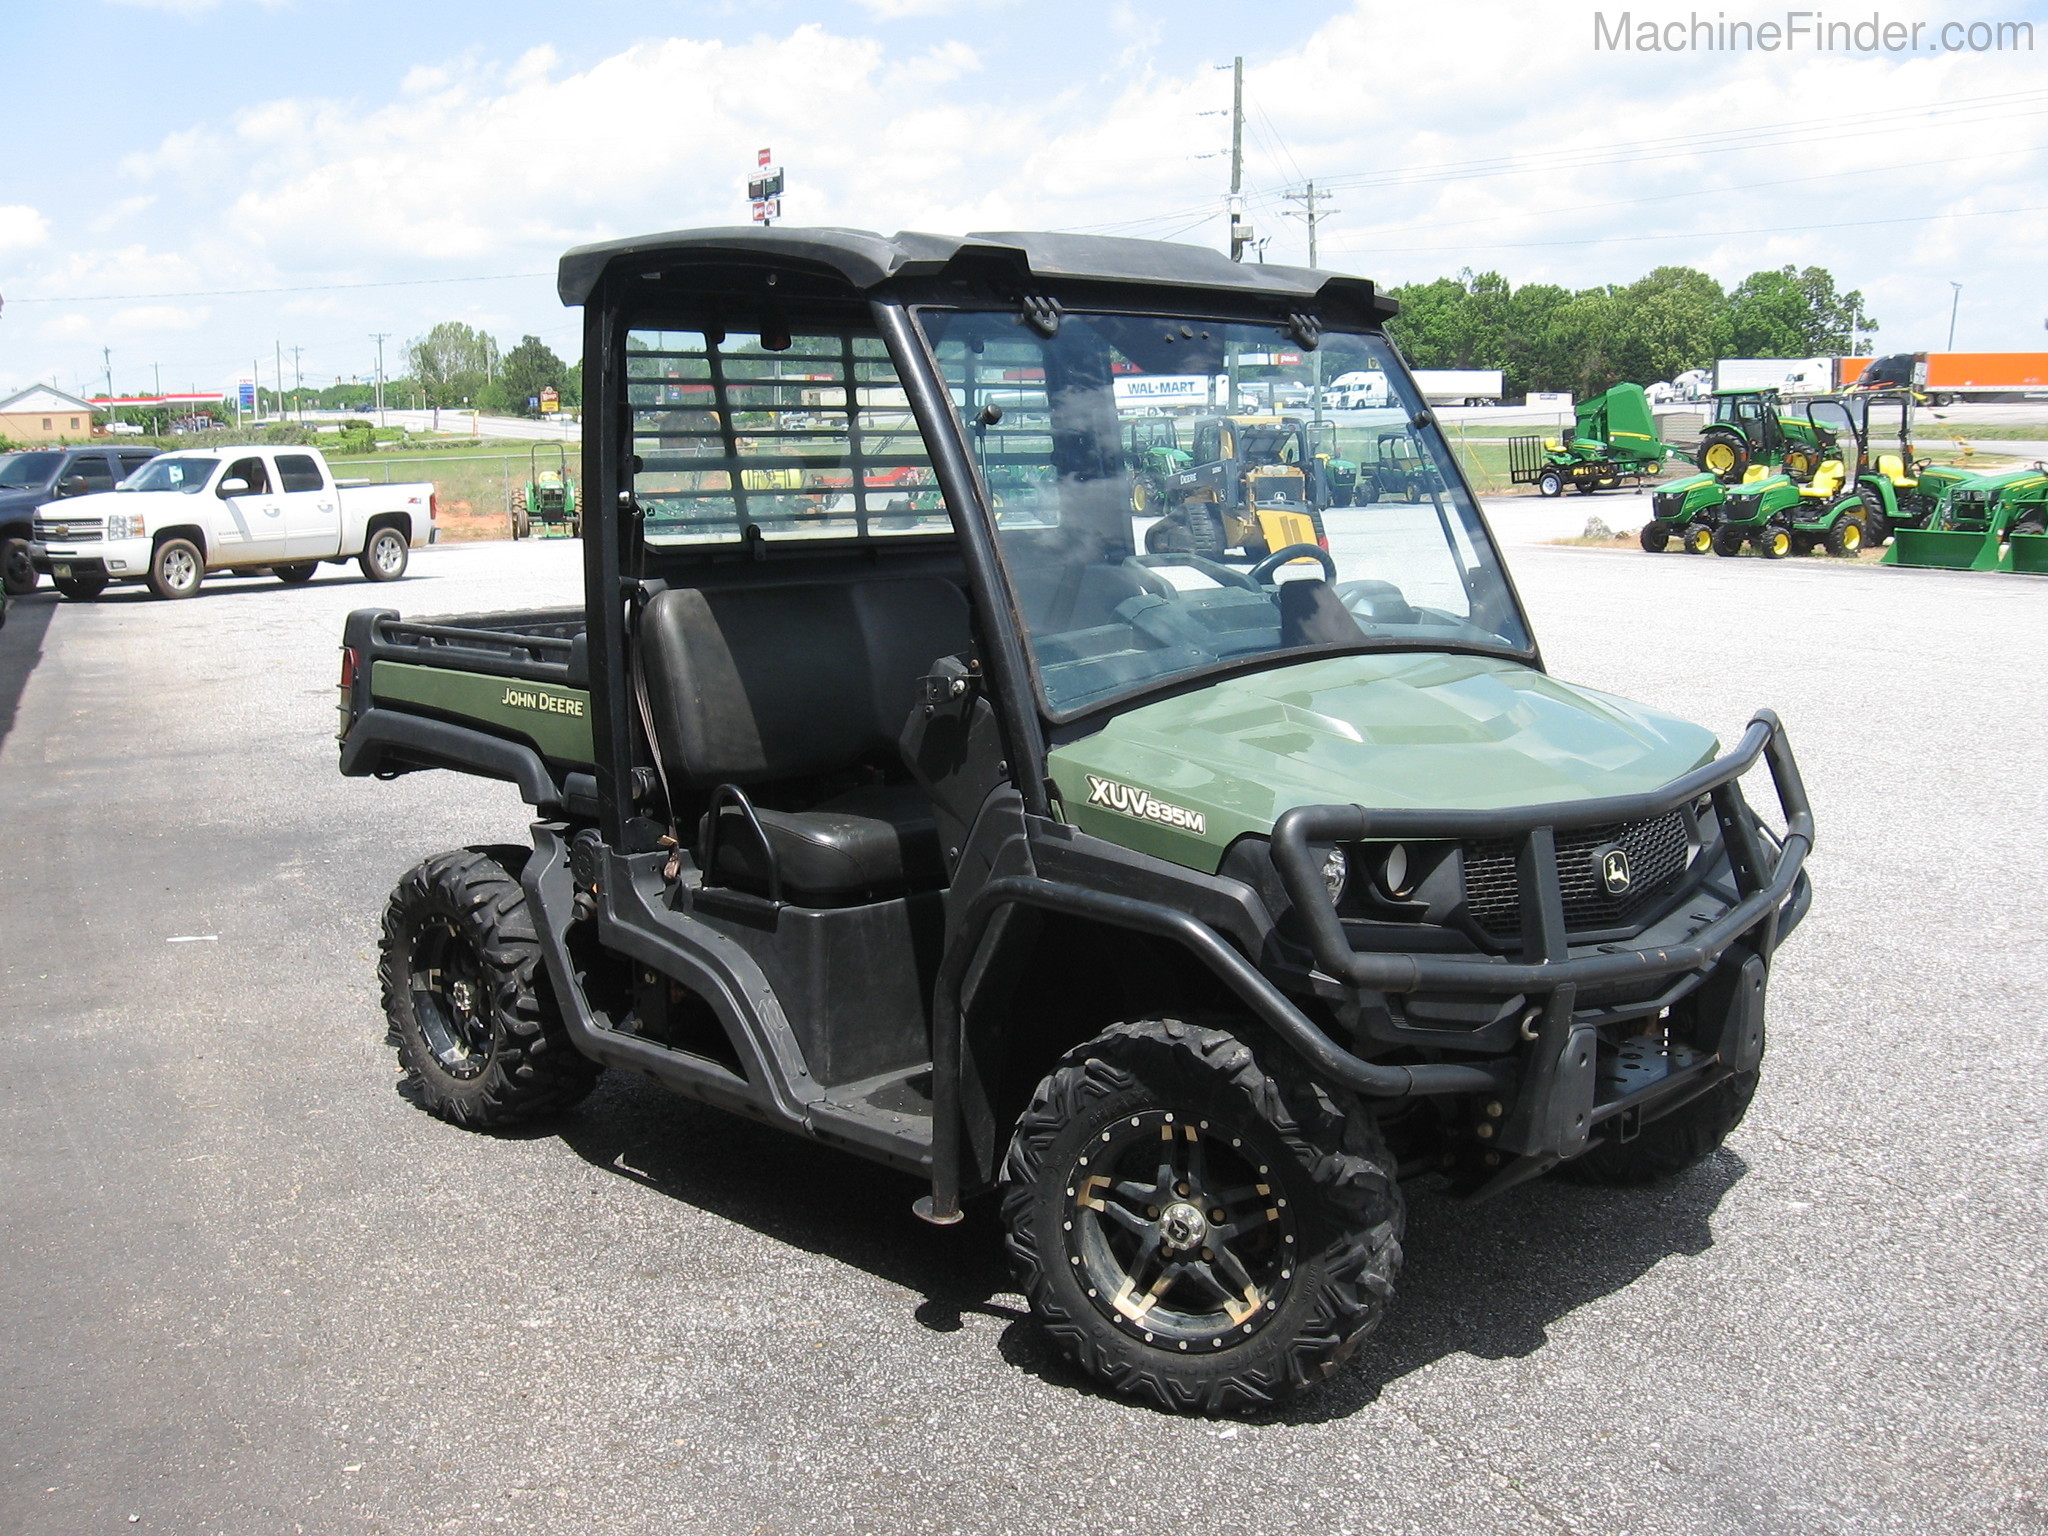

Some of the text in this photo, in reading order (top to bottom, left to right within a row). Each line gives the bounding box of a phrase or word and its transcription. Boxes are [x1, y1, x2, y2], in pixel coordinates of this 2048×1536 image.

[1180, 472, 1197, 485] DEERE
[501, 687, 584, 717] JOHN DEERE
[1086, 775, 1205, 834] XUV835M
